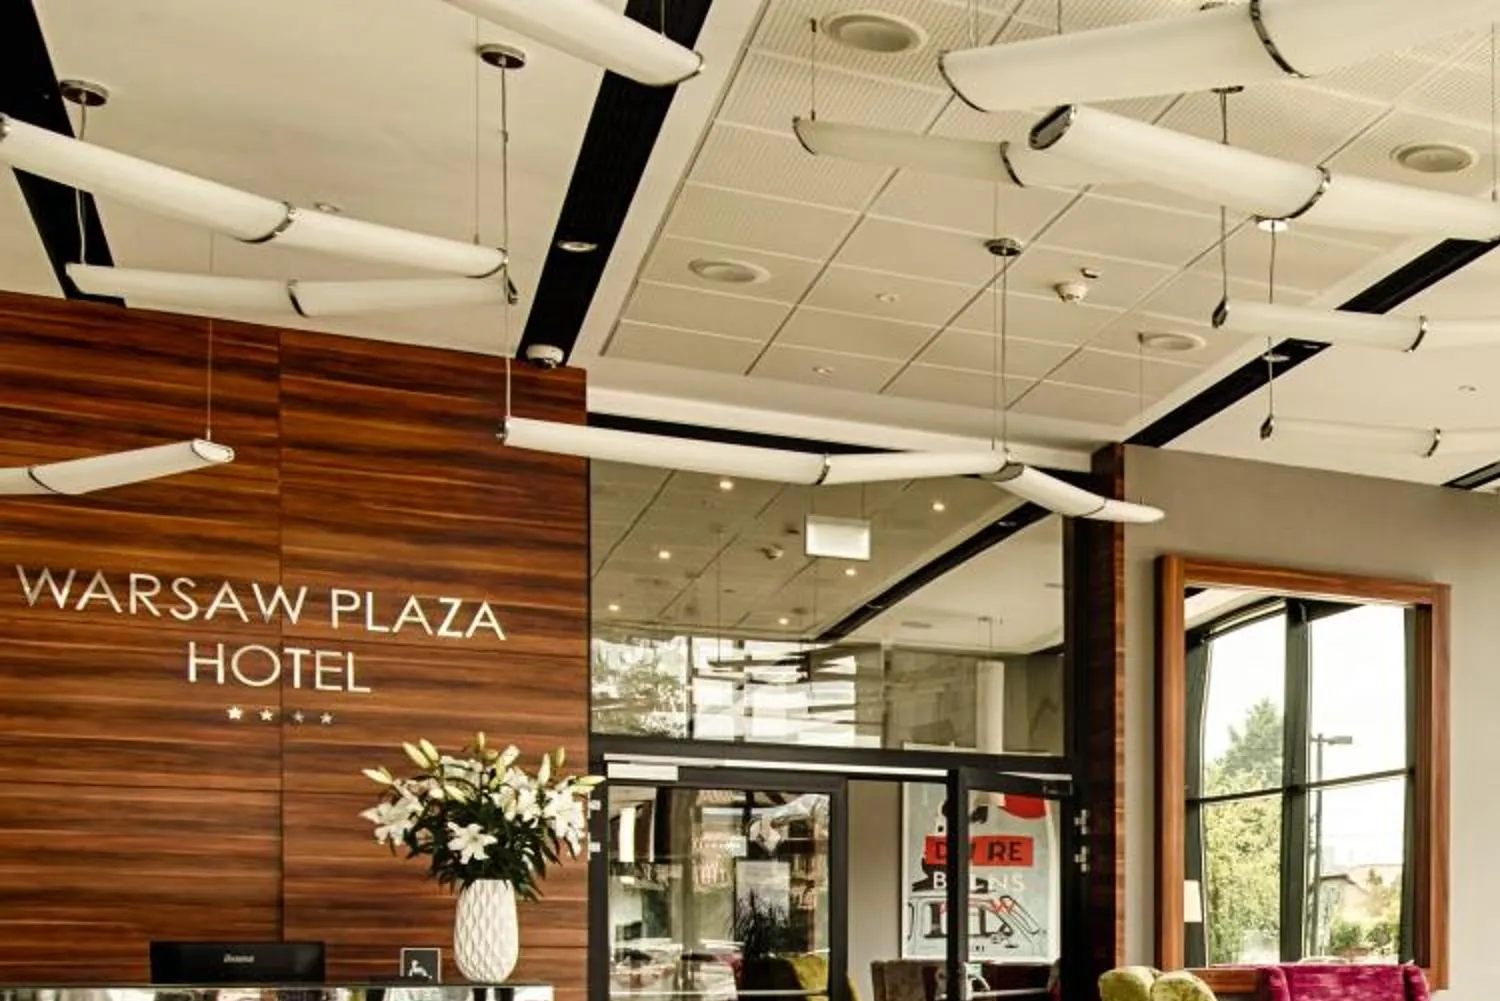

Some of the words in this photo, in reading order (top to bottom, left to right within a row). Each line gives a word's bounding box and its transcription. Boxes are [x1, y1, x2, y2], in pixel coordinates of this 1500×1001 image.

[16, 564, 308, 625] WARSAW
[331, 588, 507, 641] PLAZA
[187, 641, 372, 693] HOTEL
